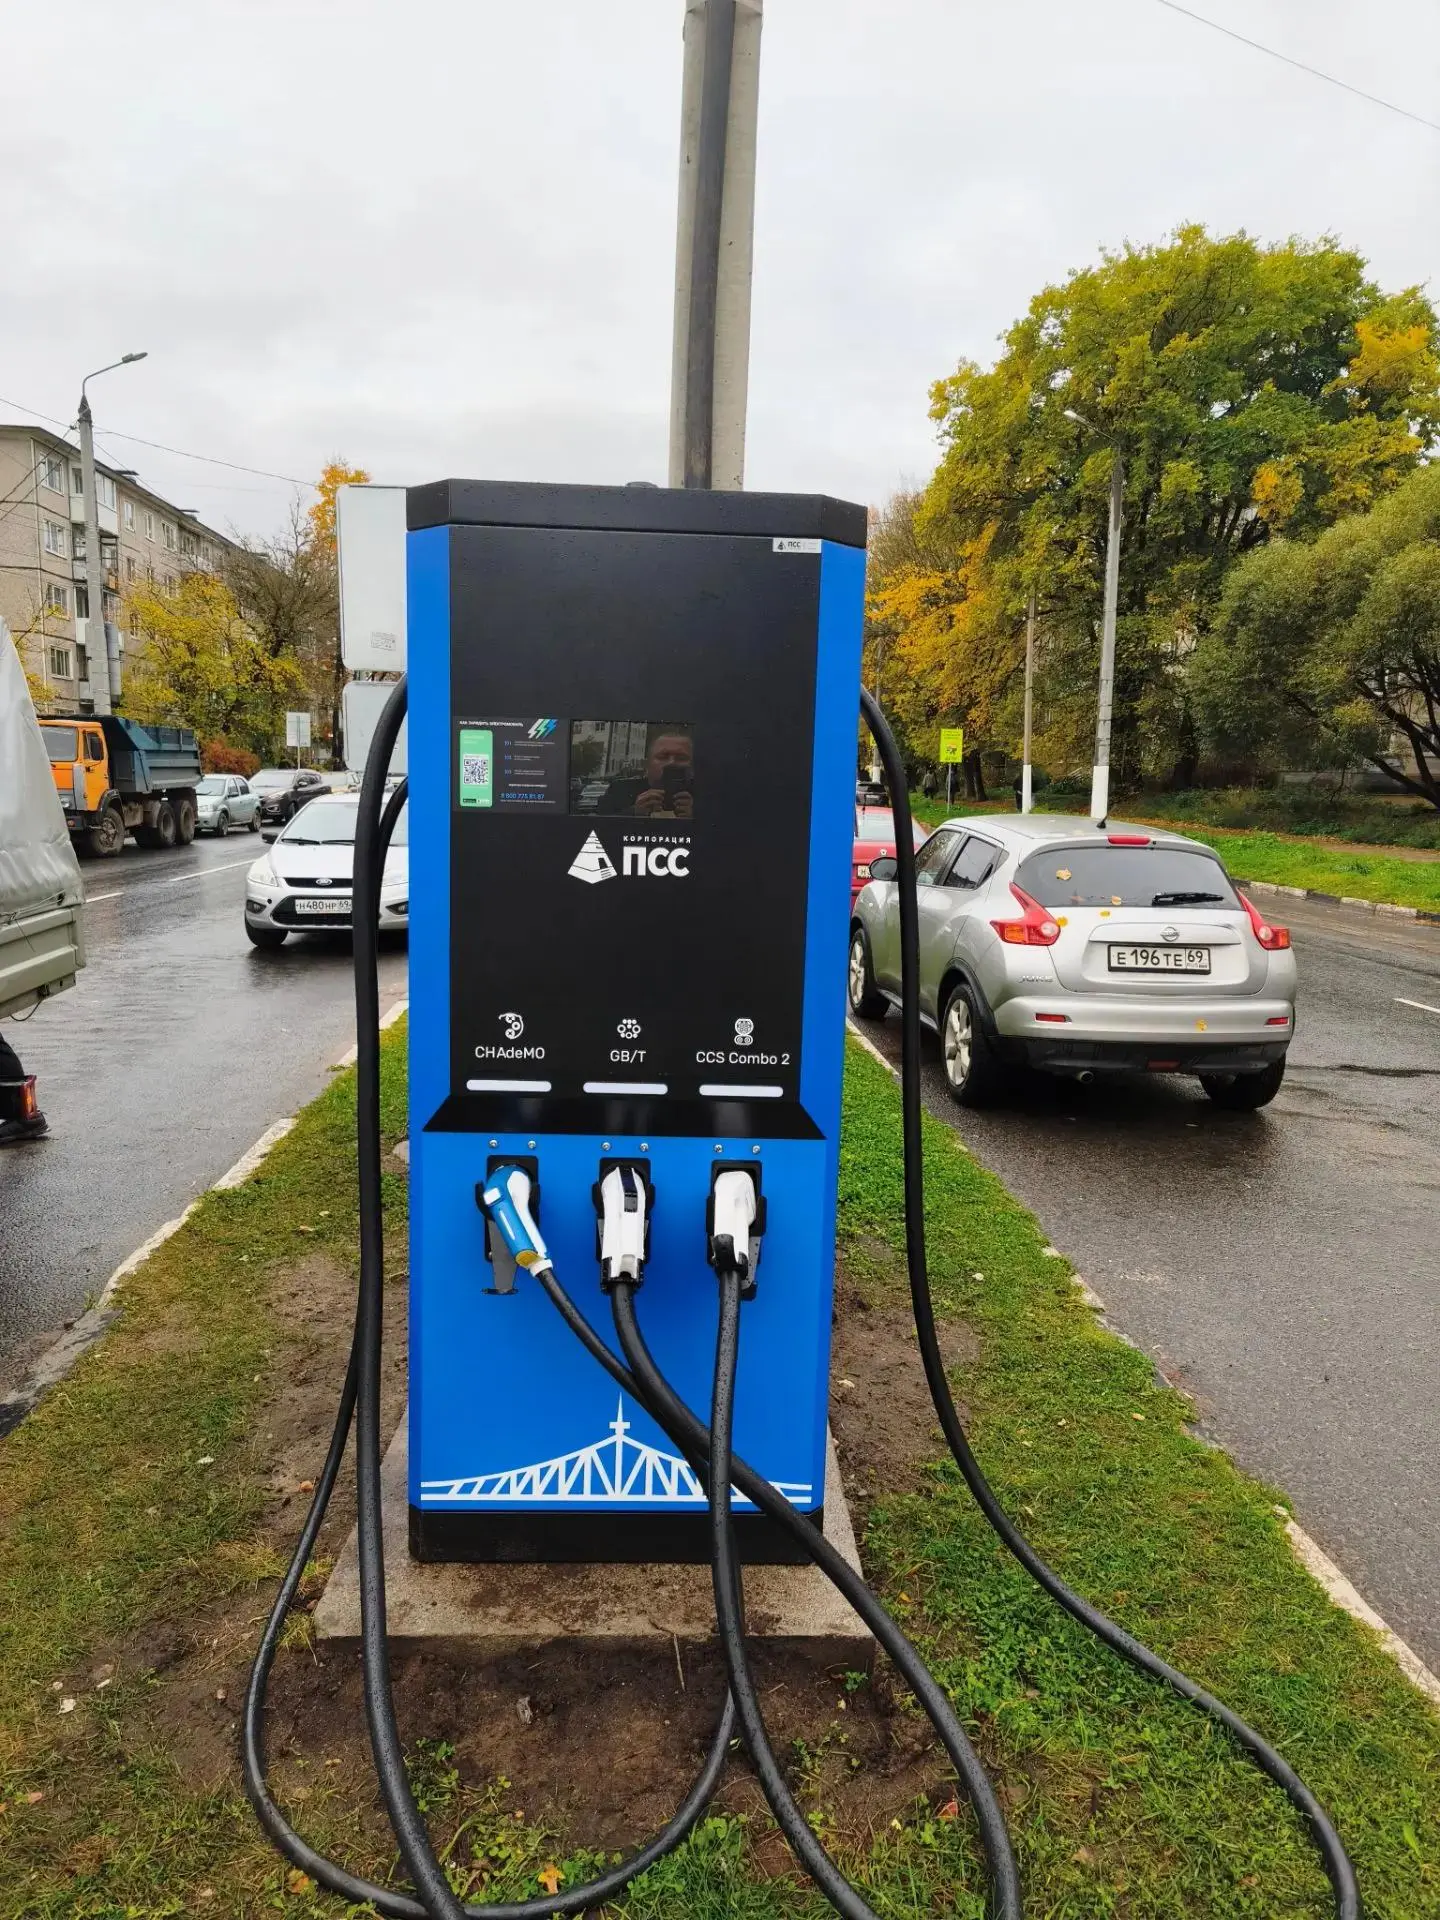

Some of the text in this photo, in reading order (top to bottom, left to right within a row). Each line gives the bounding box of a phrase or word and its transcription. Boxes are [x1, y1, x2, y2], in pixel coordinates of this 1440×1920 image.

[623, 835, 691, 844] КОРПОРАЦИЯ
[623, 846, 690, 877] ПСС
[1187, 950, 1203, 963] 69
[474, 1046, 546, 1060] CHAdeMO
[609, 1050, 647, 1063] GB/T
[696, 1051, 790, 1065] CCS Combo 2
